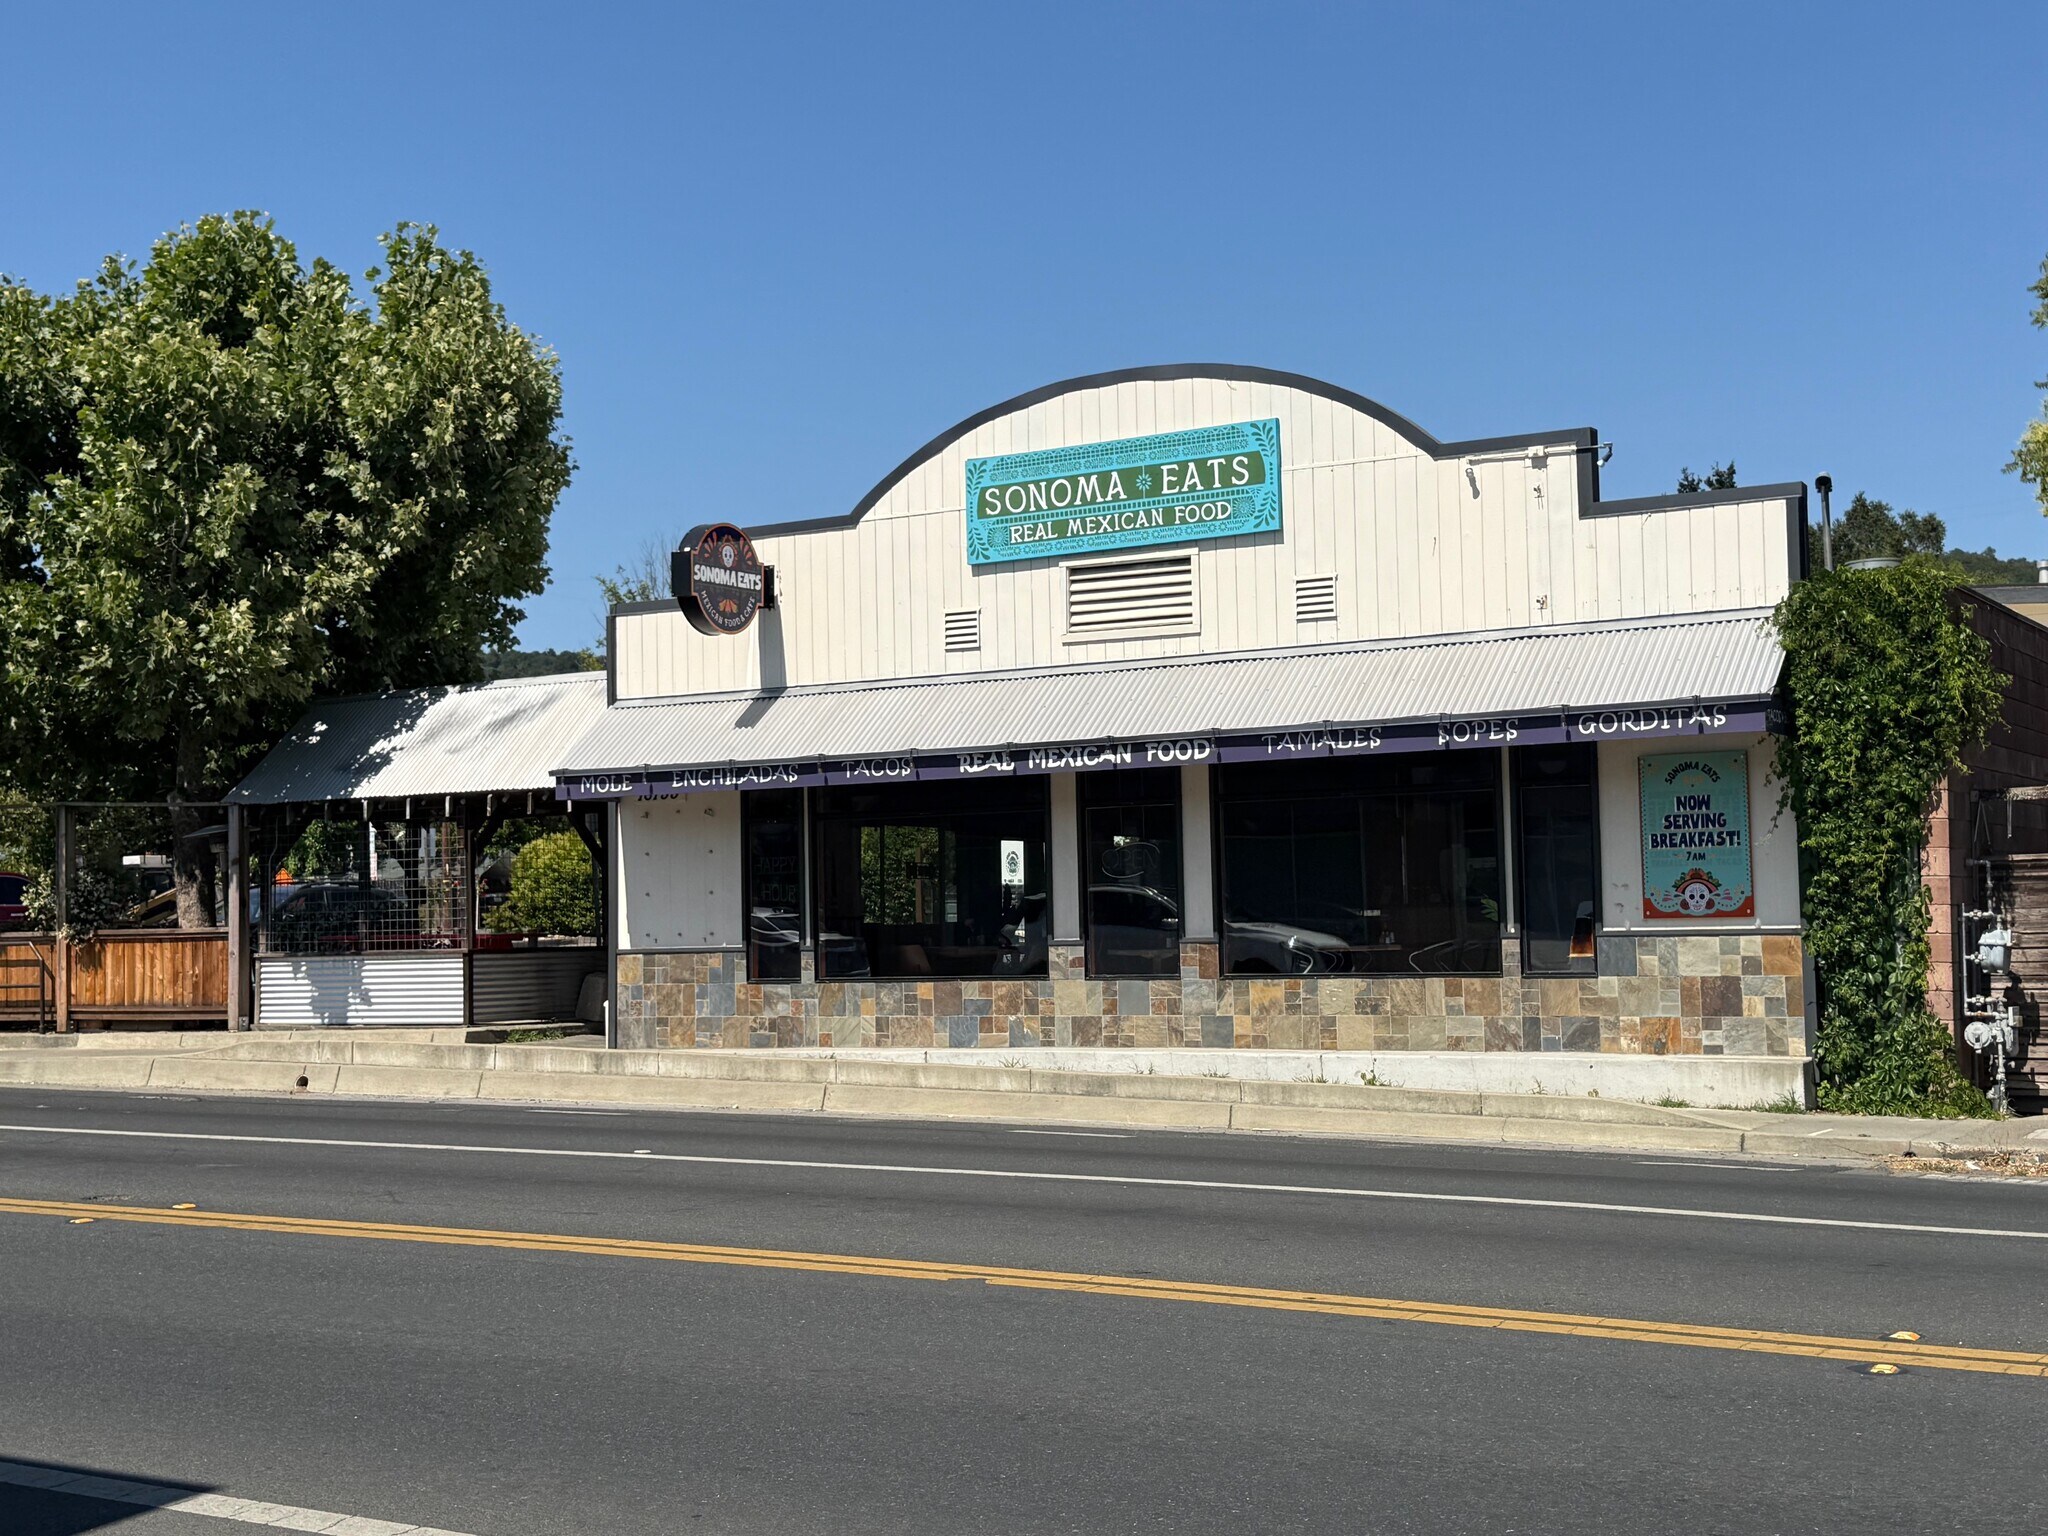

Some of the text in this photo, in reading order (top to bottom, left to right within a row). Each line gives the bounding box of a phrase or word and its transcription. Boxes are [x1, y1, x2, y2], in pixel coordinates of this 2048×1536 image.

[985, 455, 1249, 516] SONOMA EATS
[1009, 501, 1231, 544] REAL MEXICAN FOOD
[694, 564, 761, 591] SONOMA EATS
[701, 590, 723, 625] MEXICAN
[724, 617, 741, 627] FOOD
[580, 704, 1729, 794] MOLE ENCHILADAS TACOS REAL MEXICAN FOOD TAMALES SOPES GORDITAS
[1665, 761, 1721, 785] SONOMA EATS
[1674, 794, 1711, 812] NOW
[1663, 813, 1727, 830] SERVING
[1649, 830, 1741, 849] BREAKFAST!
[754, 855, 797, 873] HAPPY
[1102, 848, 1157, 870] OPEN
[760, 884, 796, 903] HOUR
